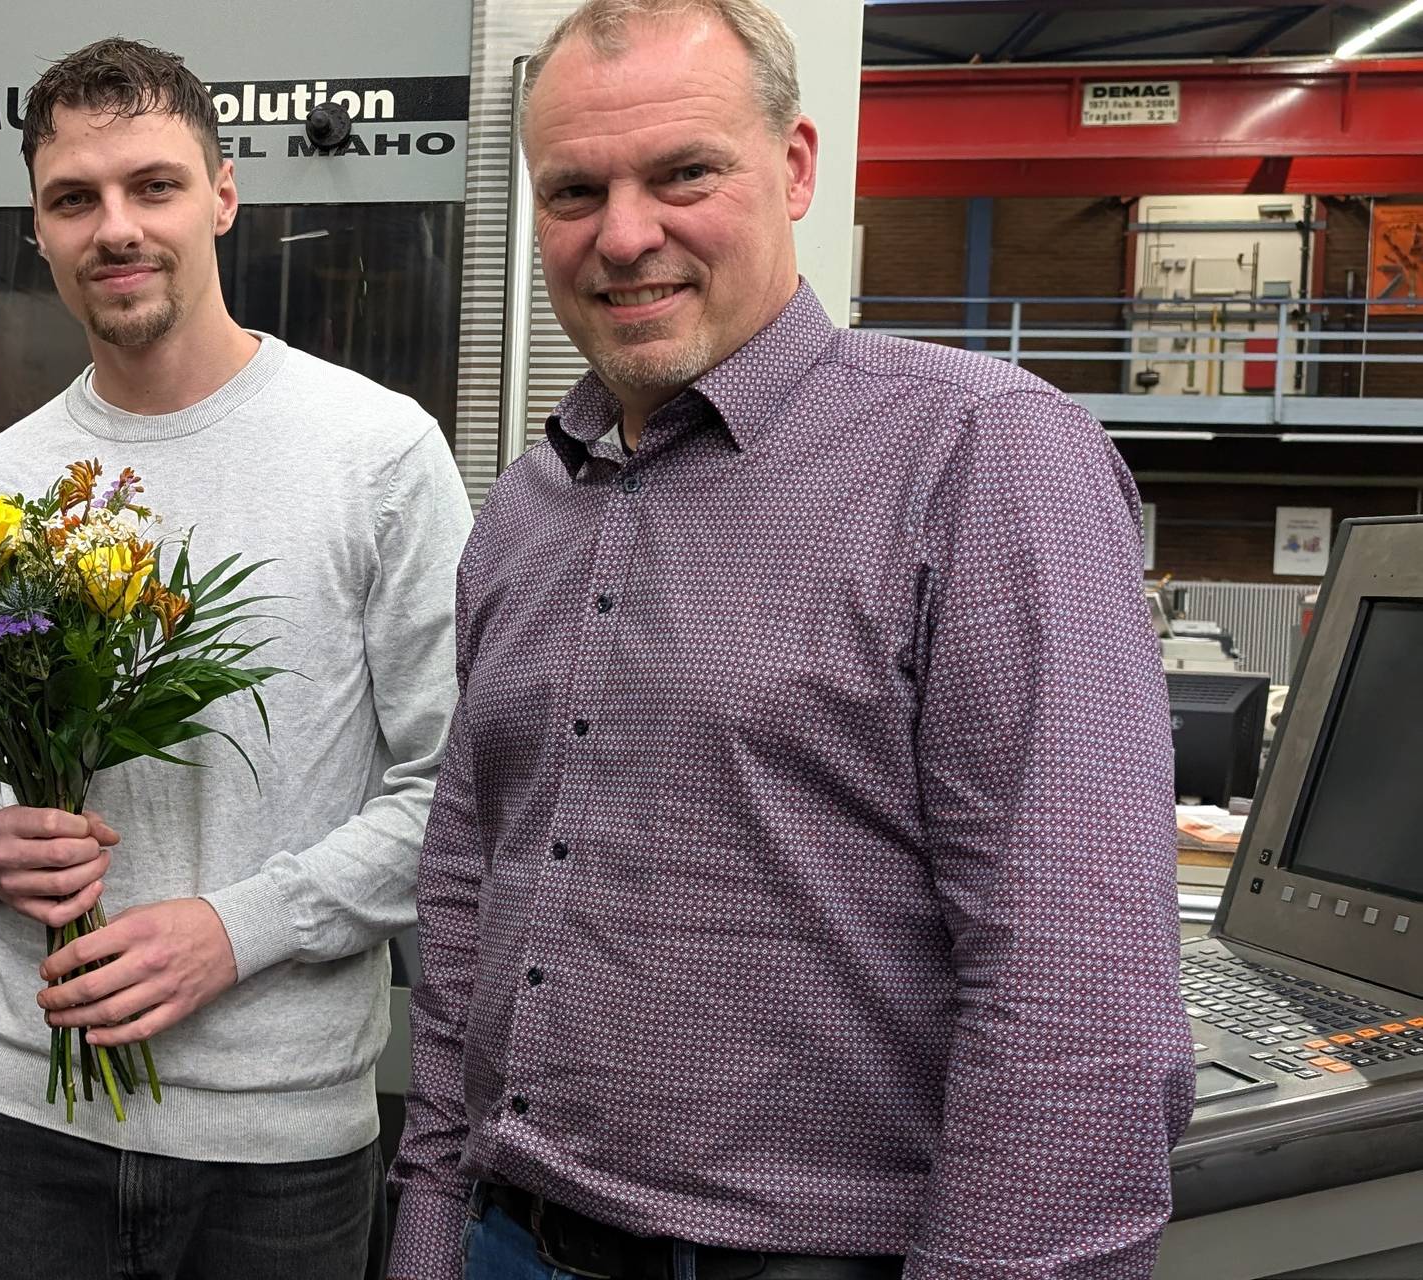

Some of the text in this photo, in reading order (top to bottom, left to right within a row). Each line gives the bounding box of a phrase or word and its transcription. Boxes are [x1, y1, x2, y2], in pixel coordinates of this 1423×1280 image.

[1092, 85, 1170, 98] DEMAG
[204, 81, 395, 124] olution
[1084, 110, 1132, 124] Traglast
[217, 132, 456, 157] EL MAHO
